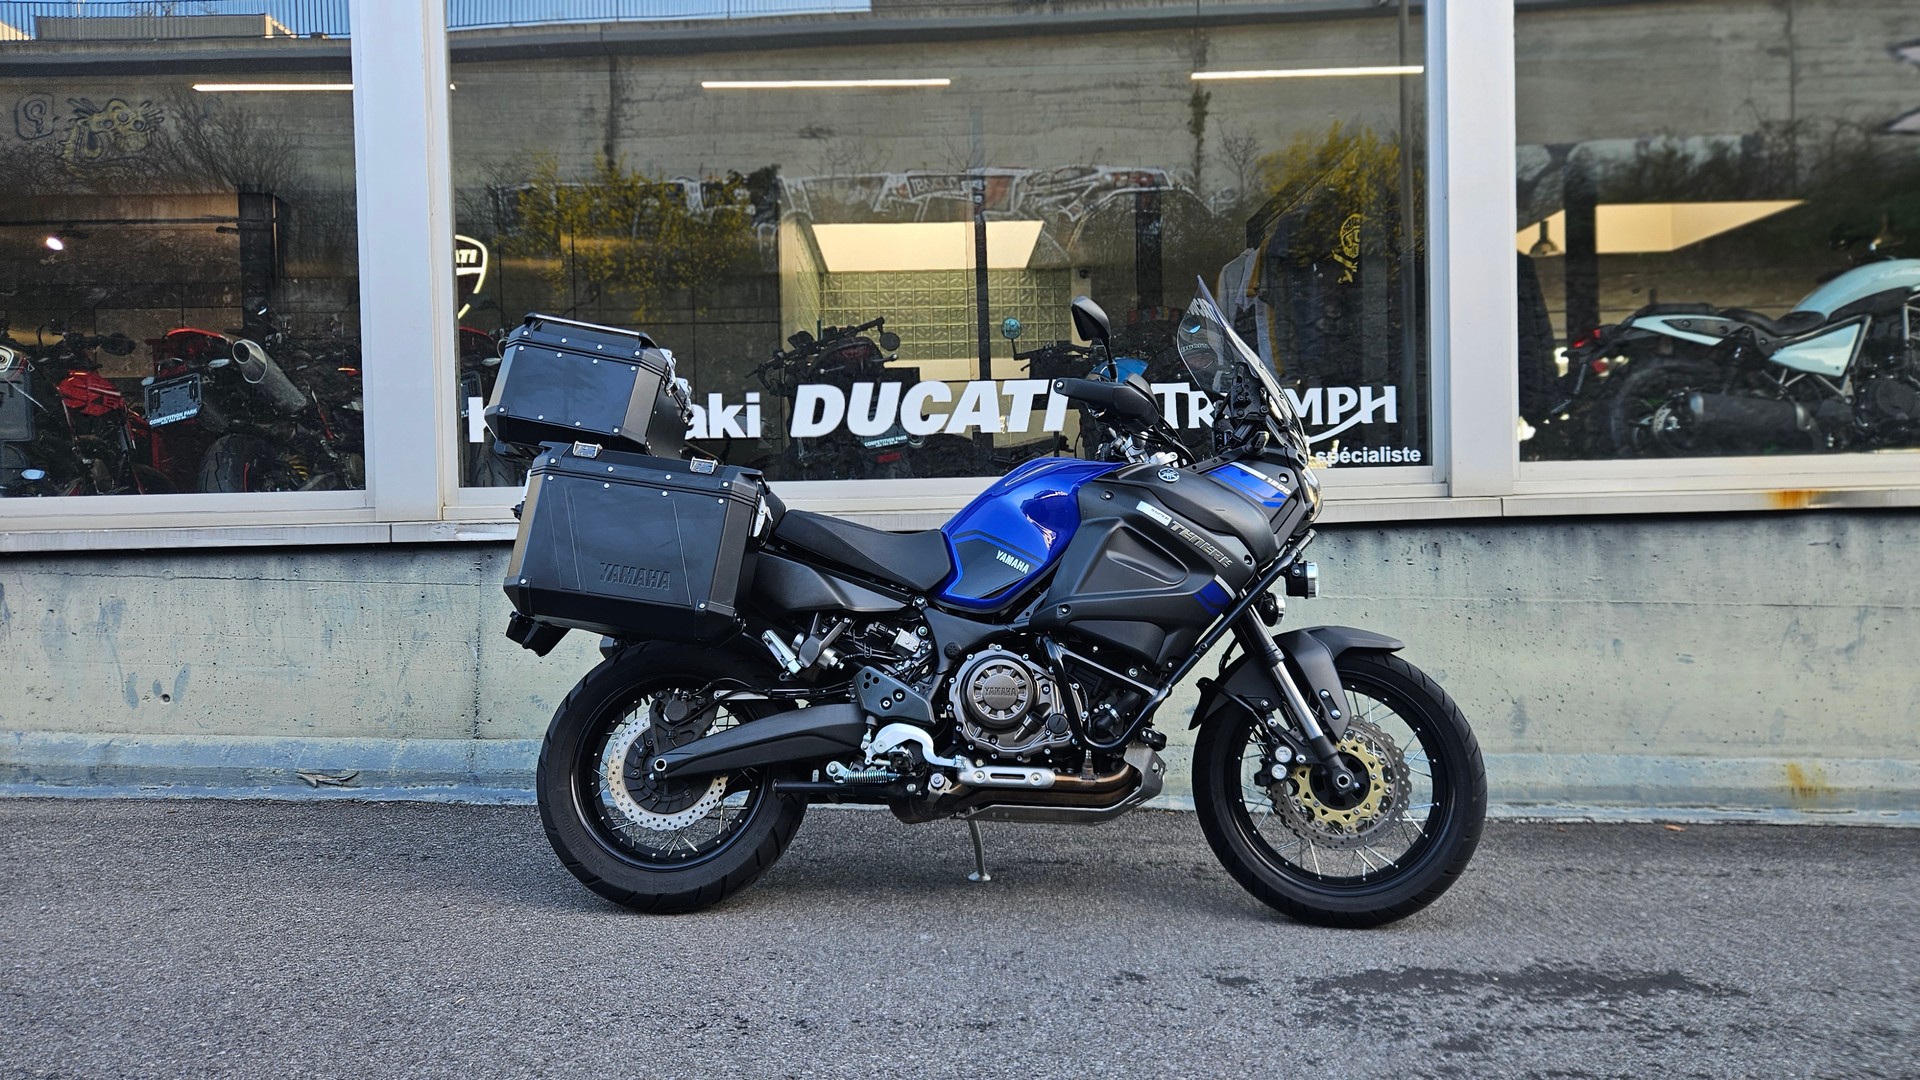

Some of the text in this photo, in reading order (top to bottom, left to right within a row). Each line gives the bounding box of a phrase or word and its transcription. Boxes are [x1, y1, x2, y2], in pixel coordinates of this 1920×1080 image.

[790, 379, 1068, 437] DUCATI
[1315, 446, 1421, 467] spécialiste
[1266, 477, 1292, 495] 1200
[996, 549, 1030, 574] YAMAHA
[600, 562, 671, 591] YAMAHA
[985, 686, 1017, 696] YAMAHA
